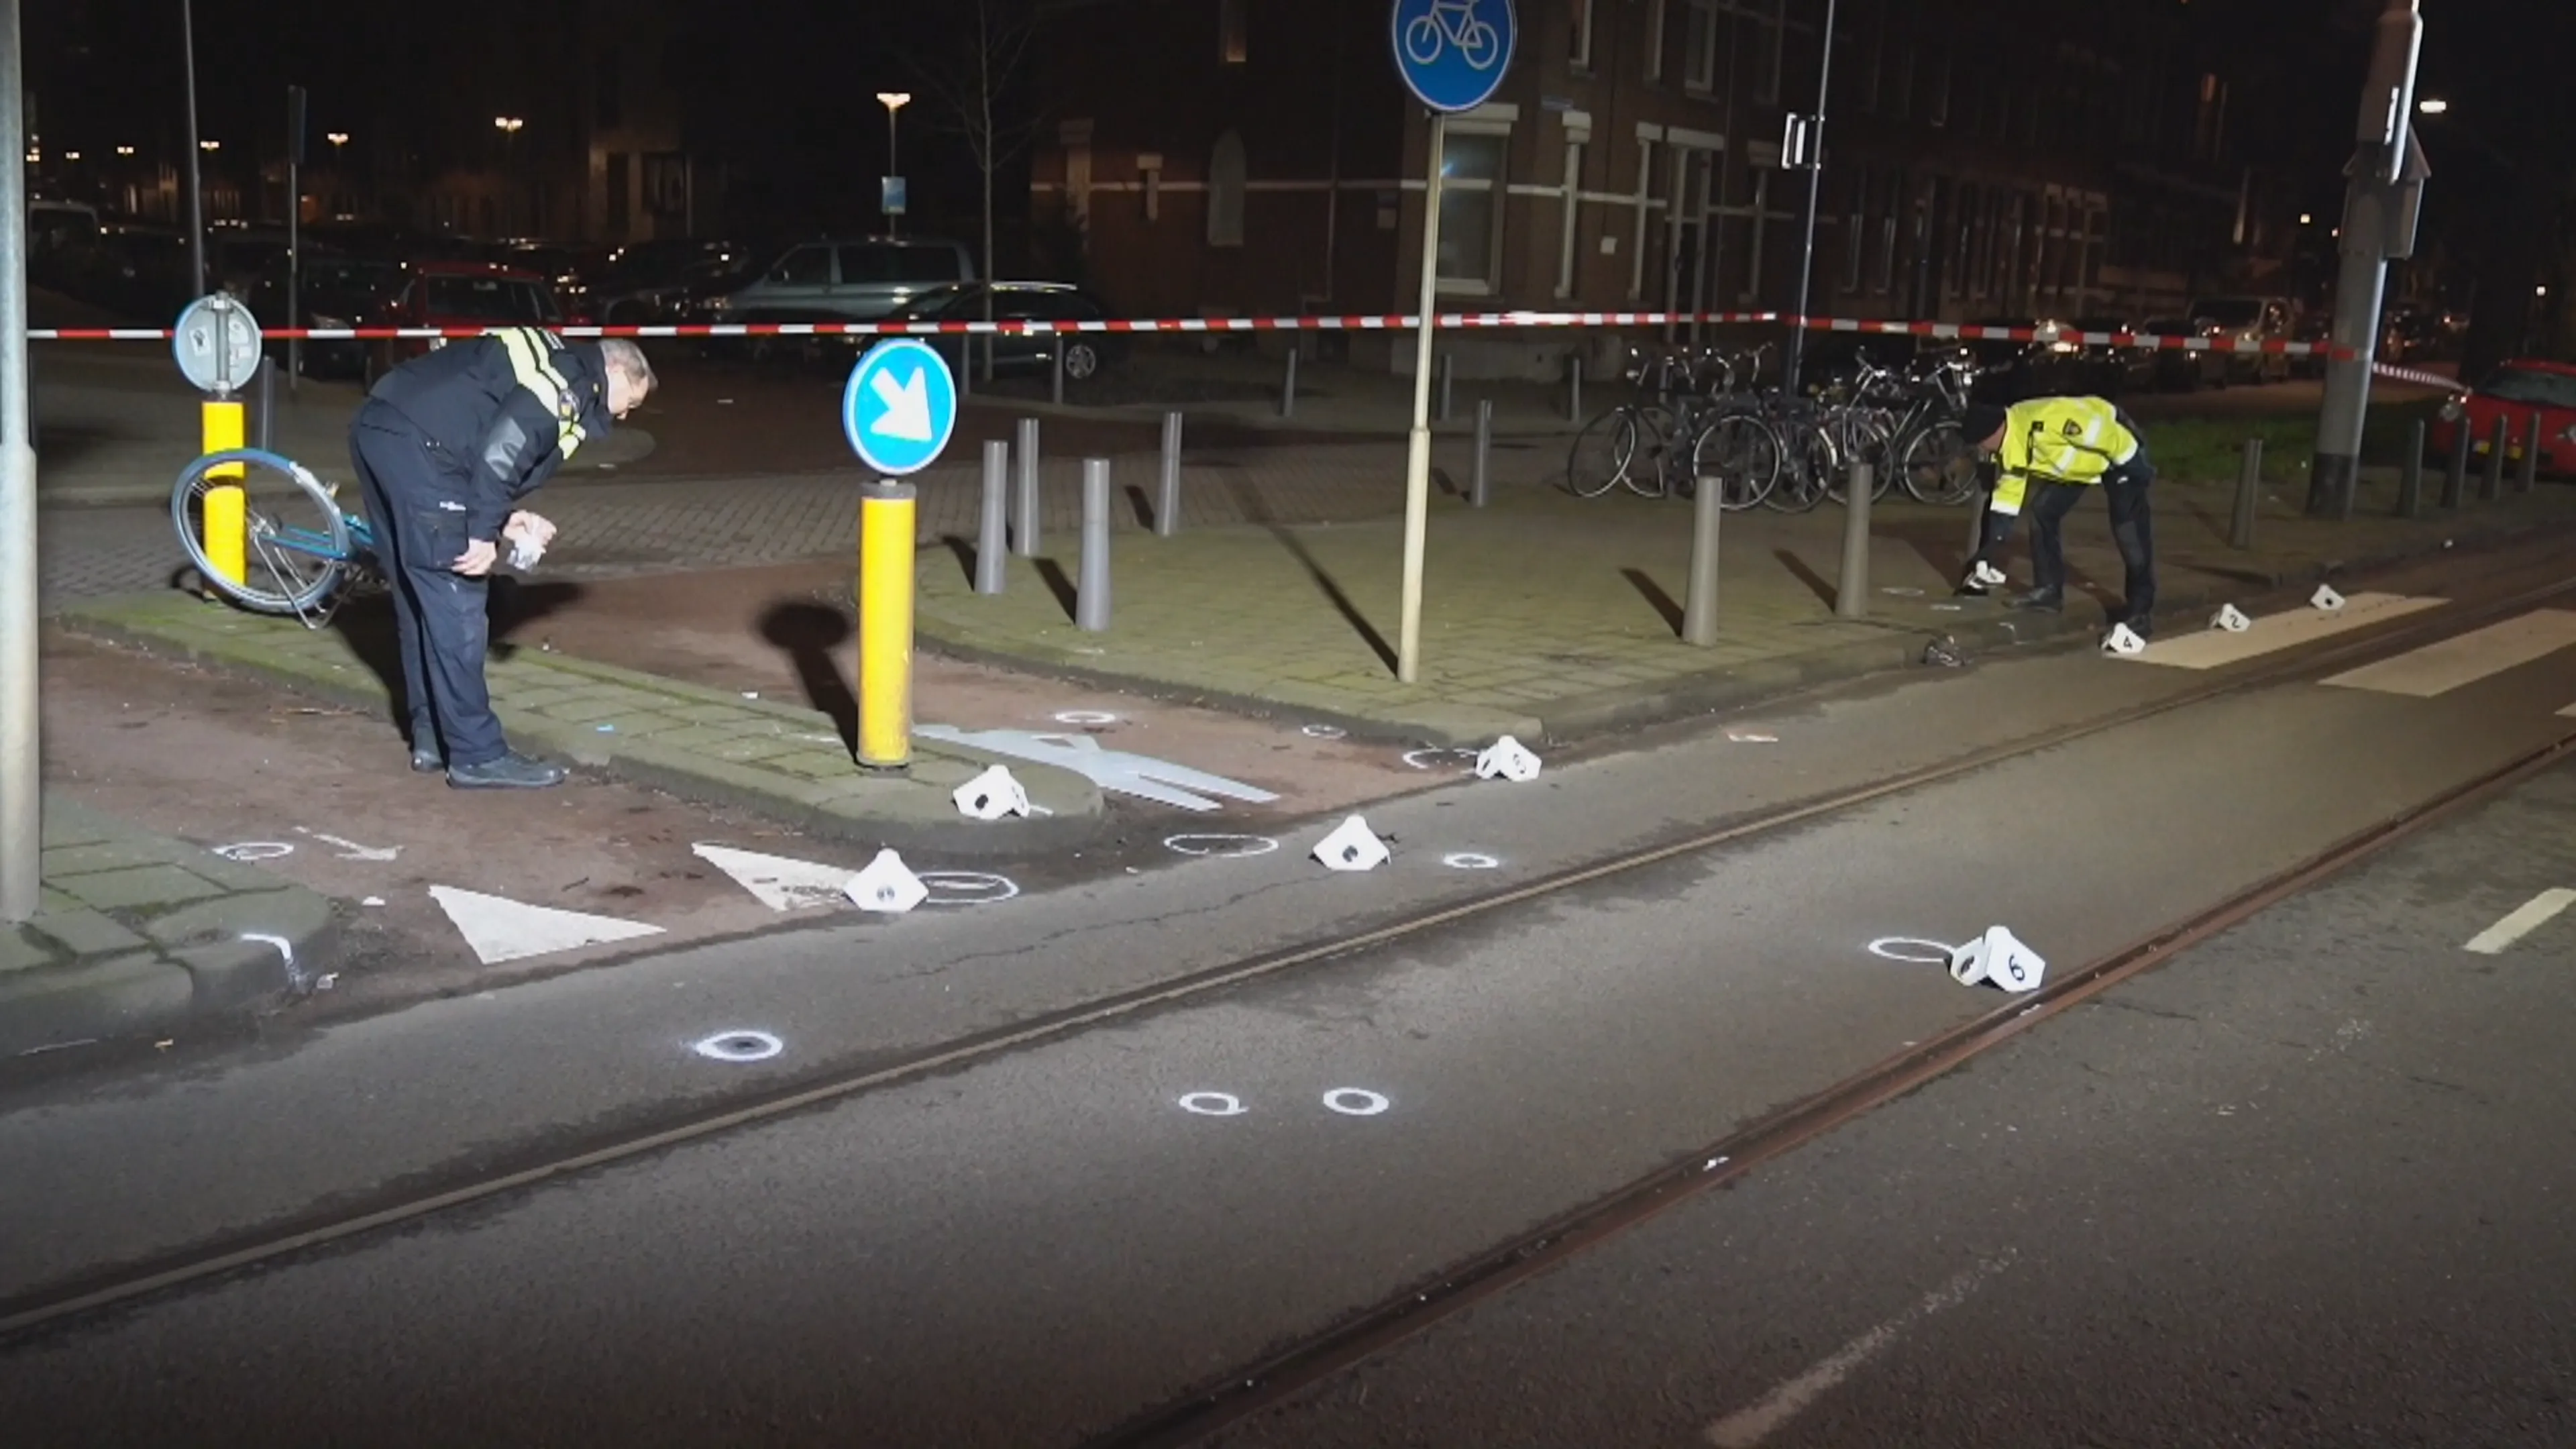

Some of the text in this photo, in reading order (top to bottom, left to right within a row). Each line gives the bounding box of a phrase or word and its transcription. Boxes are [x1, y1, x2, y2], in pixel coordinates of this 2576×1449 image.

[2230, 614, 2241, 628] 2
[2123, 636, 2132, 649] 4
[2008, 954, 2025, 981] 6
